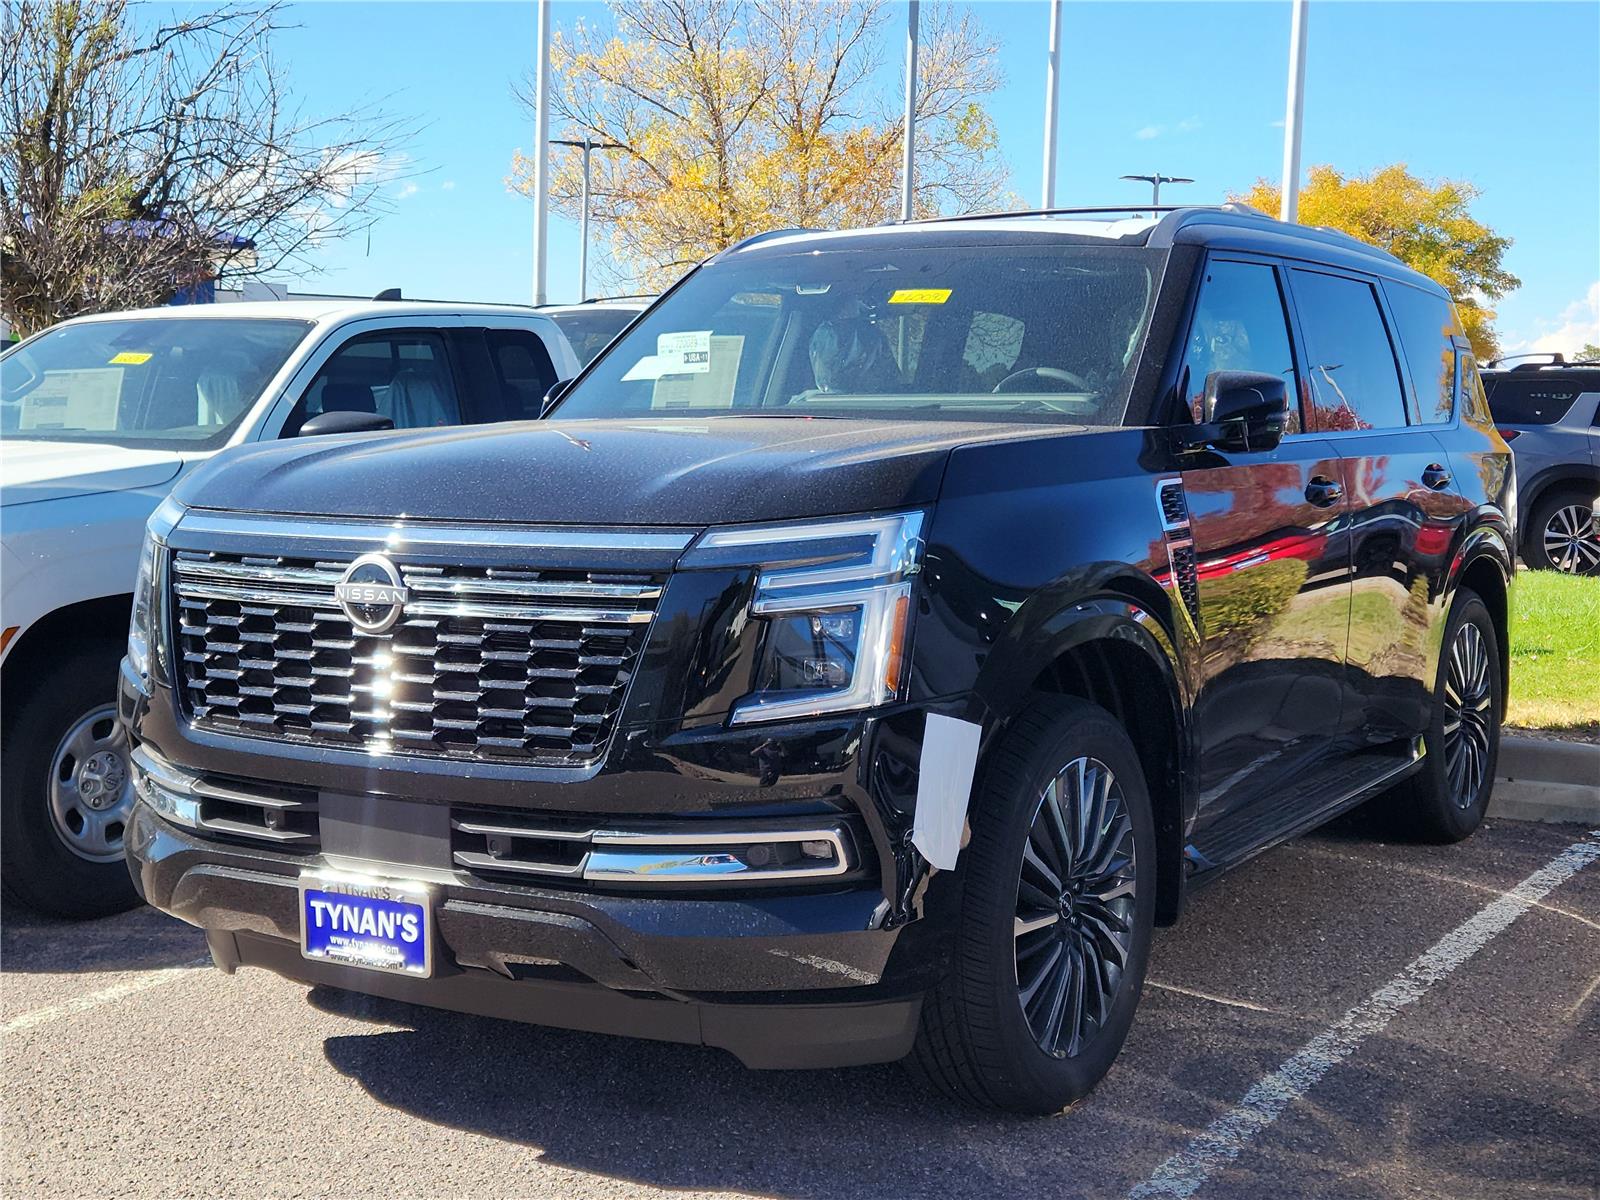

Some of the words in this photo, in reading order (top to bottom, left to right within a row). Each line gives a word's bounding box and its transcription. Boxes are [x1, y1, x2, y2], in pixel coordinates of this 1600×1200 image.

[336, 587, 406, 602] NISSAN
[336, 882, 391, 900] TYNAN'S
[309, 900, 418, 943] TYNAN'S
[329, 935, 399, 955] www.tyna.com
